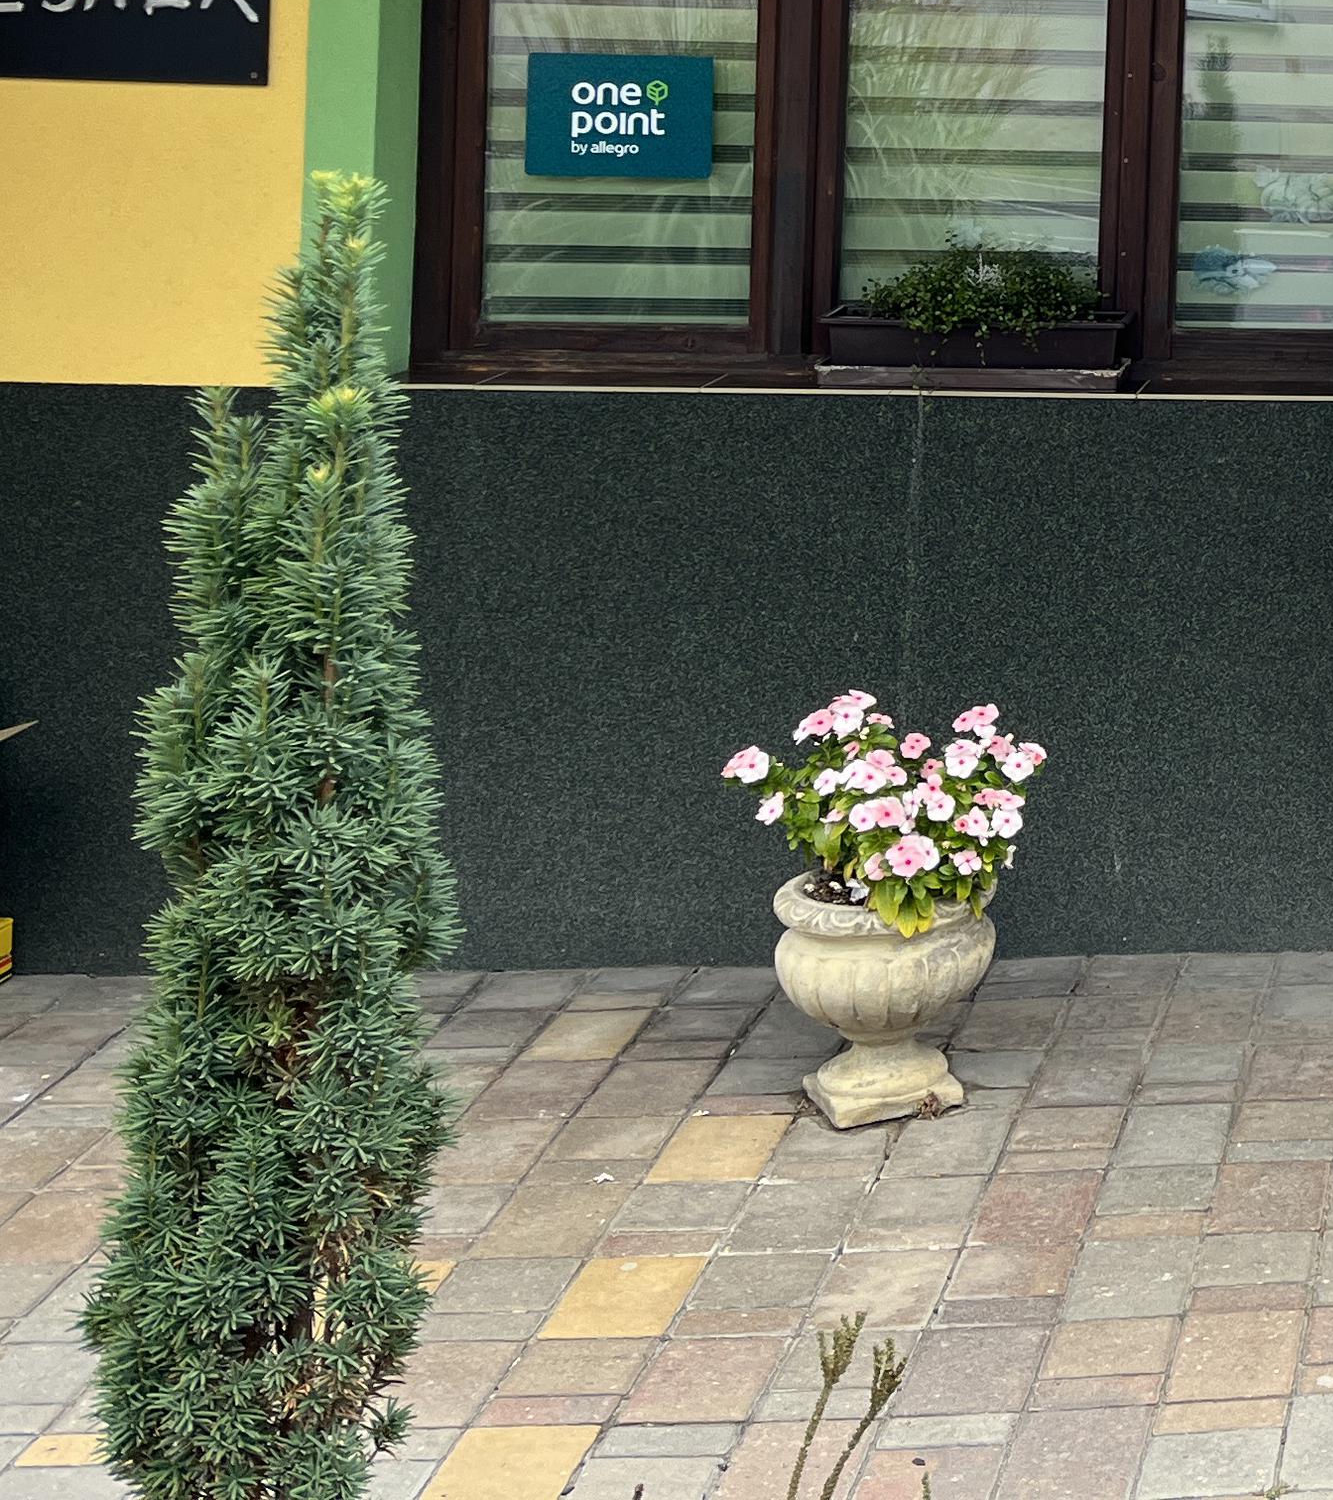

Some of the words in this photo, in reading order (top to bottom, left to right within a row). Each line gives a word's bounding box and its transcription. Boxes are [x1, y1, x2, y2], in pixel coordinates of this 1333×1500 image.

[571, 82, 642, 106] one
[571, 108, 665, 138] point
[571, 141, 588, 156] by
[590, 141, 639, 157] allegro
